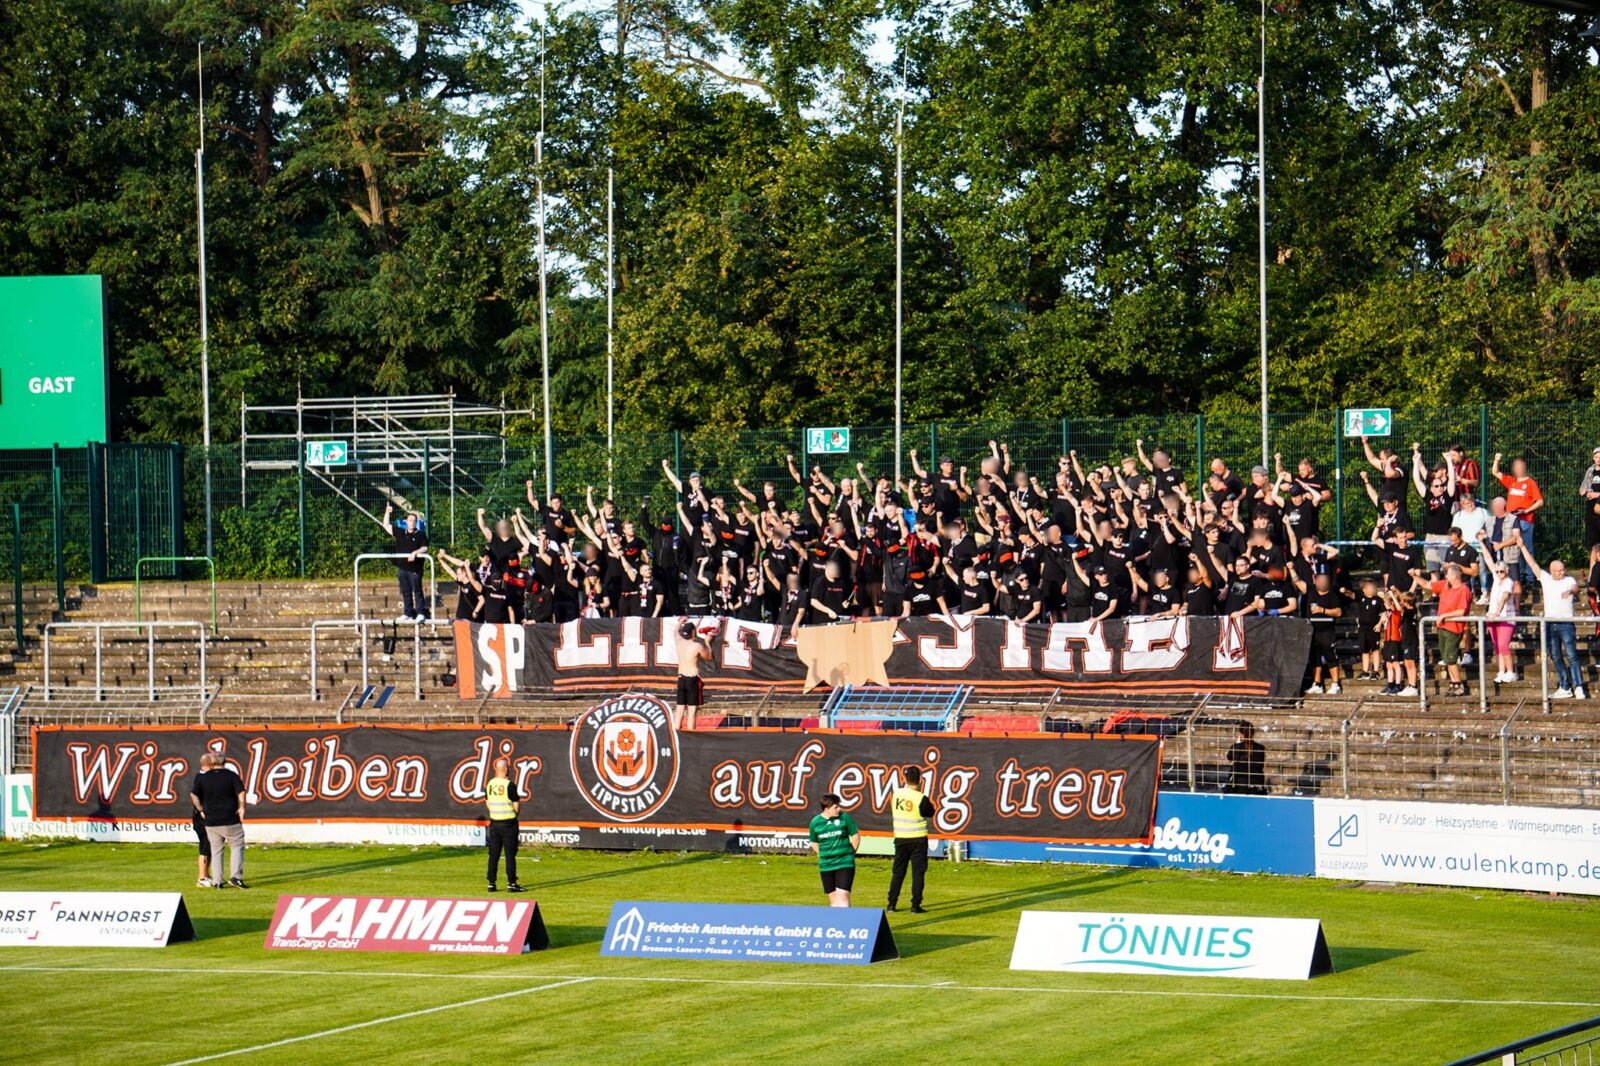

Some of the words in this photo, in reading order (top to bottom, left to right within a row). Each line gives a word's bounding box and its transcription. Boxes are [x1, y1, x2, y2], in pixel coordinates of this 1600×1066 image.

[29, 377, 75, 394] GAST
[477, 622, 526, 694] SP
[586, 698, 666, 730] SPIELVEREIN
[578, 746, 590, 758] 19
[67, 741, 188, 804] Wir
[710, 739, 826, 810] auf
[830, 745, 980, 836] ewig
[997, 757, 1128, 821] treu
[488, 784, 505, 796] K9
[590, 782, 662, 814] LIPPSTADT
[895, 797, 913, 812] K9
[11, 821, 108, 834] VERSICHERUNG
[112, 821, 150, 832] Klaus
[386, 823, 481, 838] VERSICHERUNG
[1379, 813, 1392, 825] PV
[1402, 814, 1427, 827] Solar
[1435, 816, 1498, 831] Heizsysteme
[1508, 818, 1584, 835] Wärmepumpen
[738, 837, 810, 849] MOTORPARTS
[1168, 853, 1185, 863] est.
[1187, 853, 1210, 865] 1758
[1319, 860, 1369, 871] AULENKAMP
[1380, 852, 1600, 882] www.aulenkamp.de
[55, 910, 162, 923] PANNHORST
[273, 896, 530, 944] KAHMEN
[99, 927, 155, 936] ENTSORGUNG
[646, 921, 700, 935] Friedrich
[701, 923, 772, 937] Amtenbrink
[774, 926, 812, 939] GmbH
[814, 927, 823, 939] &
[825, 928, 846, 939] Co.
[848, 928, 869, 940] KG
[1077, 916, 1254, 959] TÖNNIES
[271, 936, 326, 951] TransCargo
[327, 938, 360, 950] GmbH
[428, 942, 509, 954] www.kahmen.de
[746, 948, 793, 958] Baugruppen
[806, 950, 863, 960] Werkzeugstahl
